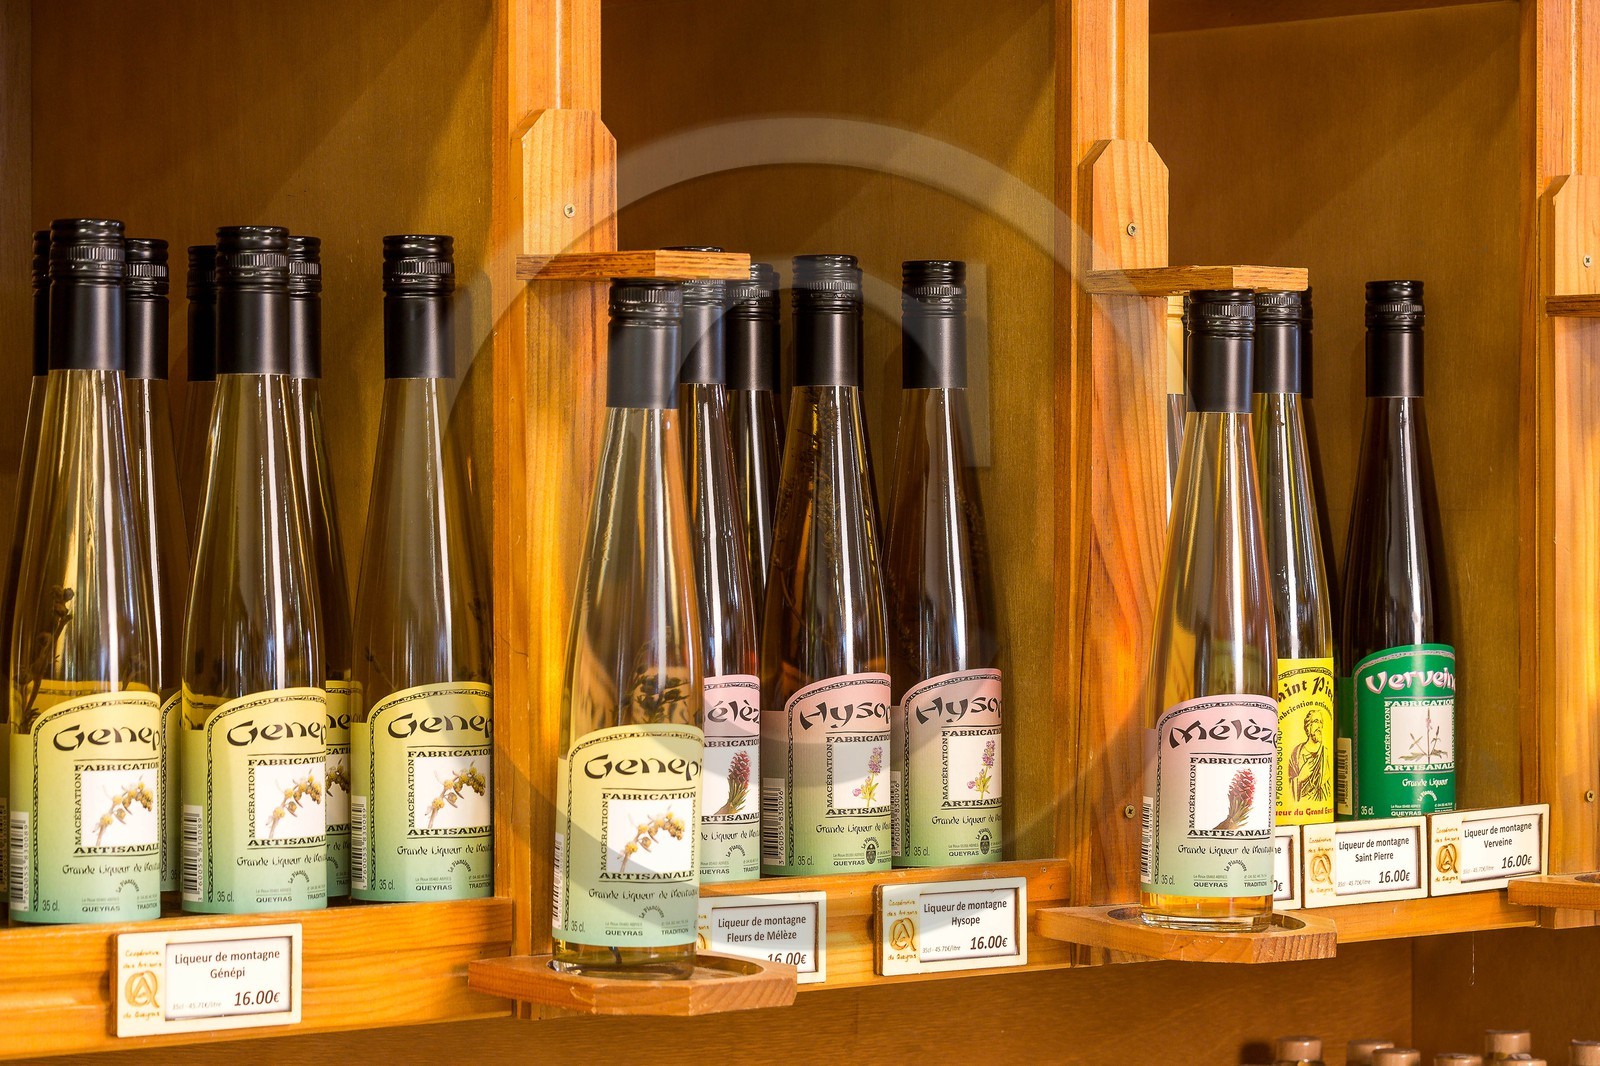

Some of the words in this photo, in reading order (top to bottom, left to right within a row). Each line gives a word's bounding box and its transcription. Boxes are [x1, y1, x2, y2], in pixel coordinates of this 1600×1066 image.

[602, 792, 696, 800] FABRICATION
[1464, 829, 1488, 838] Liqueur
[1490, 826, 1498, 834] de
[1500, 822, 1532, 833] montagne
[1338, 841, 1364, 851] Liqueur
[1367, 839, 1375, 848] de
[1376, 837, 1409, 847] montagne
[1484, 838, 1512, 848] Verveine
[914, 846, 921, 856] 35
[1355, 854, 1372, 862] Saint
[1374, 852, 1394, 860] Pierre
[798, 856, 805, 866] 35
[1502, 854, 1532, 869] 16.00€
[599, 870, 694, 879] ARTISANALE
[1161, 875, 1168, 884] 35
[1378, 870, 1410, 884] 16.00€
[379, 880, 386, 890] 35
[217, 891, 225, 902] 35
[588, 889, 619, 900] Grande
[42, 900, 50, 911] 35
[924, 904, 955, 914] Liqueur
[956, 902, 966, 911] de
[967, 900, 1007, 910] montagne
[571, 920, 578, 932] 35
[718, 918, 750, 929] Liqueur
[751, 917, 762, 926] de
[764, 916, 806, 926] montagne
[951, 916, 980, 928] Hysope
[727, 934, 752, 942] Fleurs
[754, 932, 764, 940] de
[767, 930, 797, 940] Mélèze
[970, 935, 1008, 950] 16.00€
[175, 954, 213, 965] Liqueur
[216, 953, 228, 962] de
[230, 949, 280, 962] montagne
[767, 952, 807, 965] 1600€
[210, 969, 246, 980] Génépi
[234, 990, 280, 1006] 16.00€
